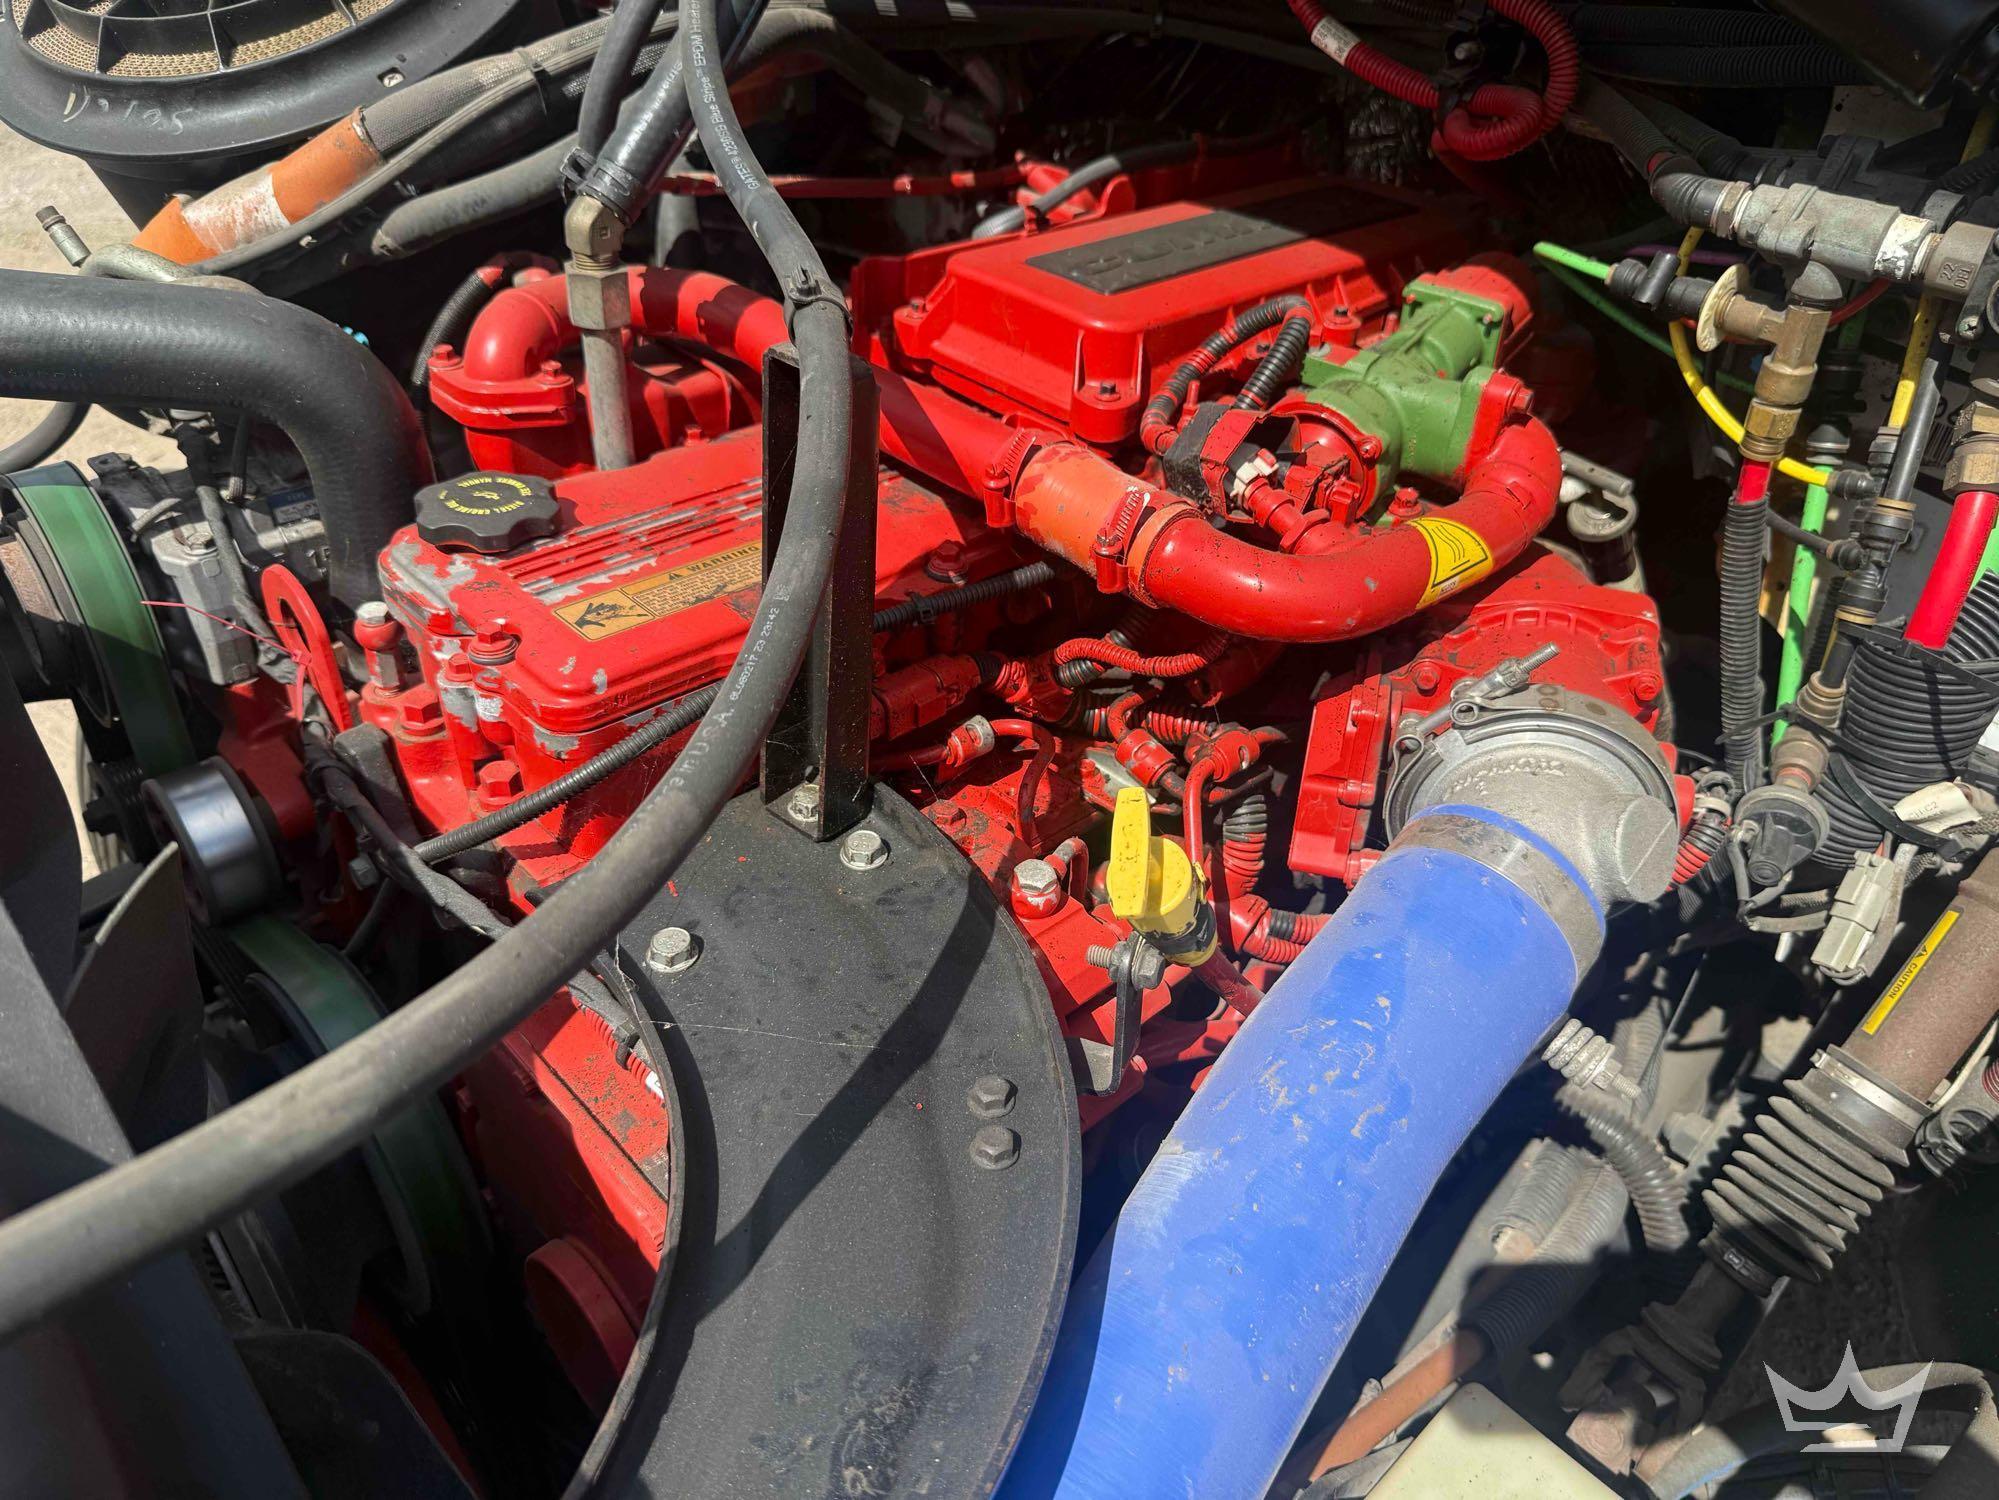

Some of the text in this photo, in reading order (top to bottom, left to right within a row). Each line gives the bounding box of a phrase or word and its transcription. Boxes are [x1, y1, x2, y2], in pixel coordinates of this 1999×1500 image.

[690, 34, 706, 67] EPDM
[710, 104, 724, 124] Blue
[1940, 262, 1956, 281] 22
[687, 546, 760, 572] WARNING
[1888, 963, 1918, 999] CAUTION
